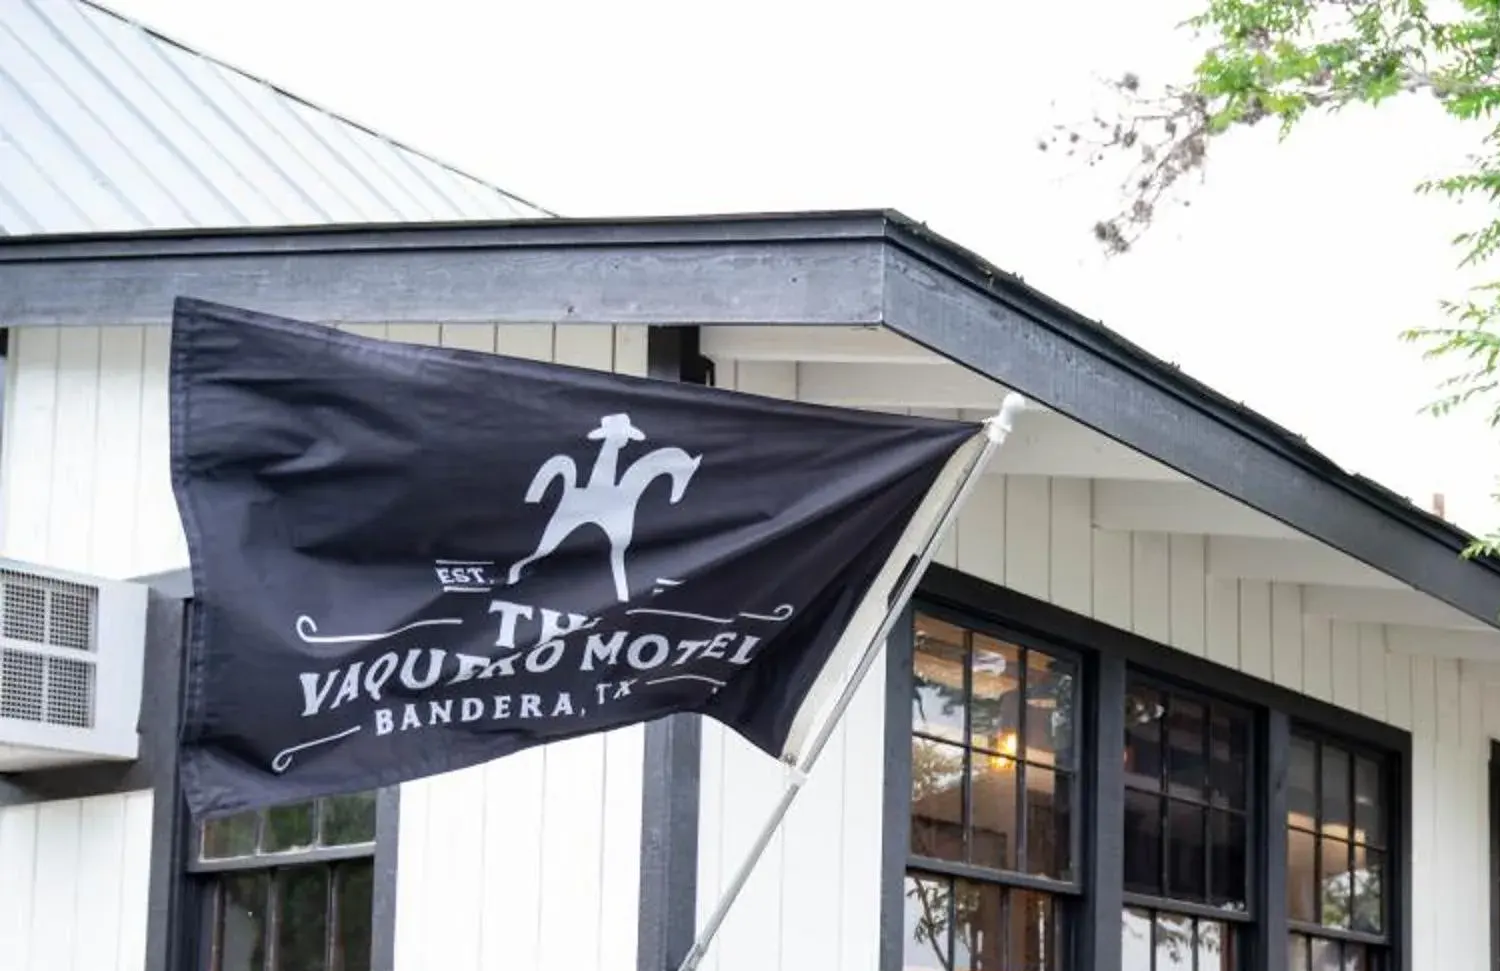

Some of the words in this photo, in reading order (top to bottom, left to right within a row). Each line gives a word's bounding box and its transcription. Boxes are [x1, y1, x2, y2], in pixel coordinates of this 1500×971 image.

[435, 566, 496, 586] EST.
[488, 600, 603, 650] TH
[579, 630, 762, 671] MOTEL
[375, 692, 587, 736] BANDERA,
[595, 678, 640, 706] TX
